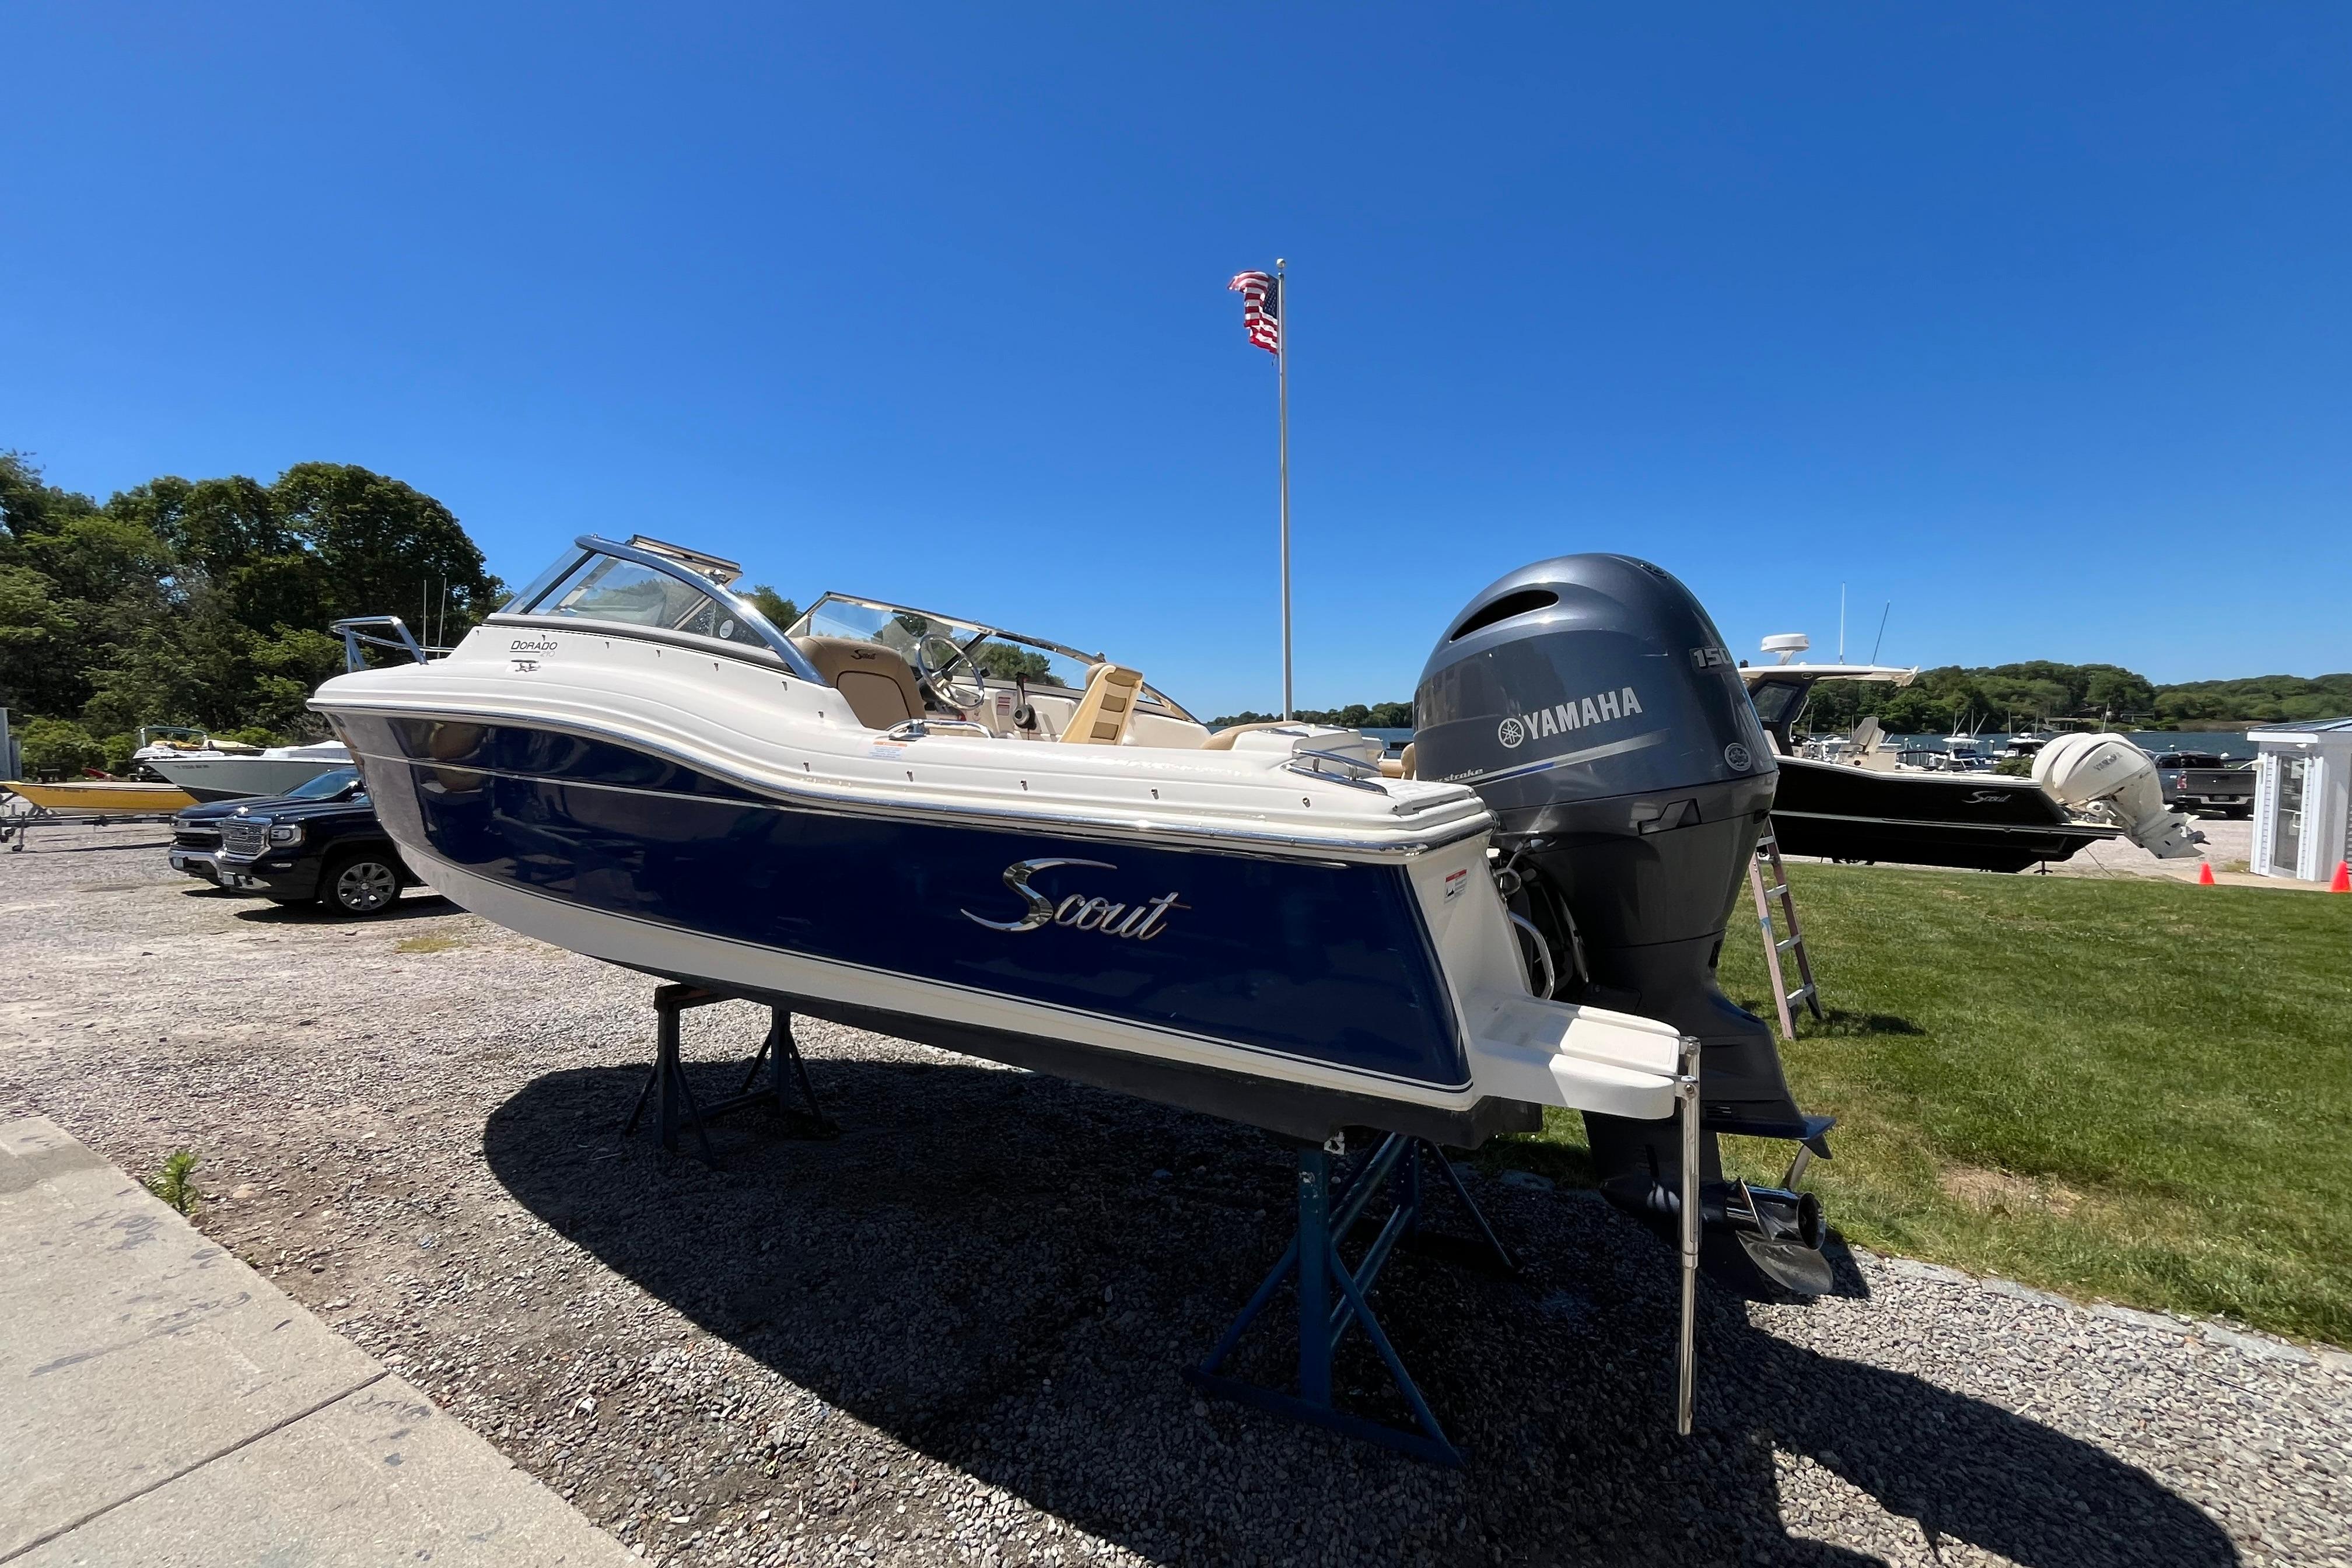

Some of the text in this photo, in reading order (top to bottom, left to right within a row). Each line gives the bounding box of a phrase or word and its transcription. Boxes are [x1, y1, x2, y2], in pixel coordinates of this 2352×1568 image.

[510, 640, 558, 650] DORADO
[1693, 648, 1732, 667] 150
[1523, 687, 1643, 740] YAMAHA
[1961, 790, 2011, 803] Scout
[960, 857, 1192, 941] Scout
